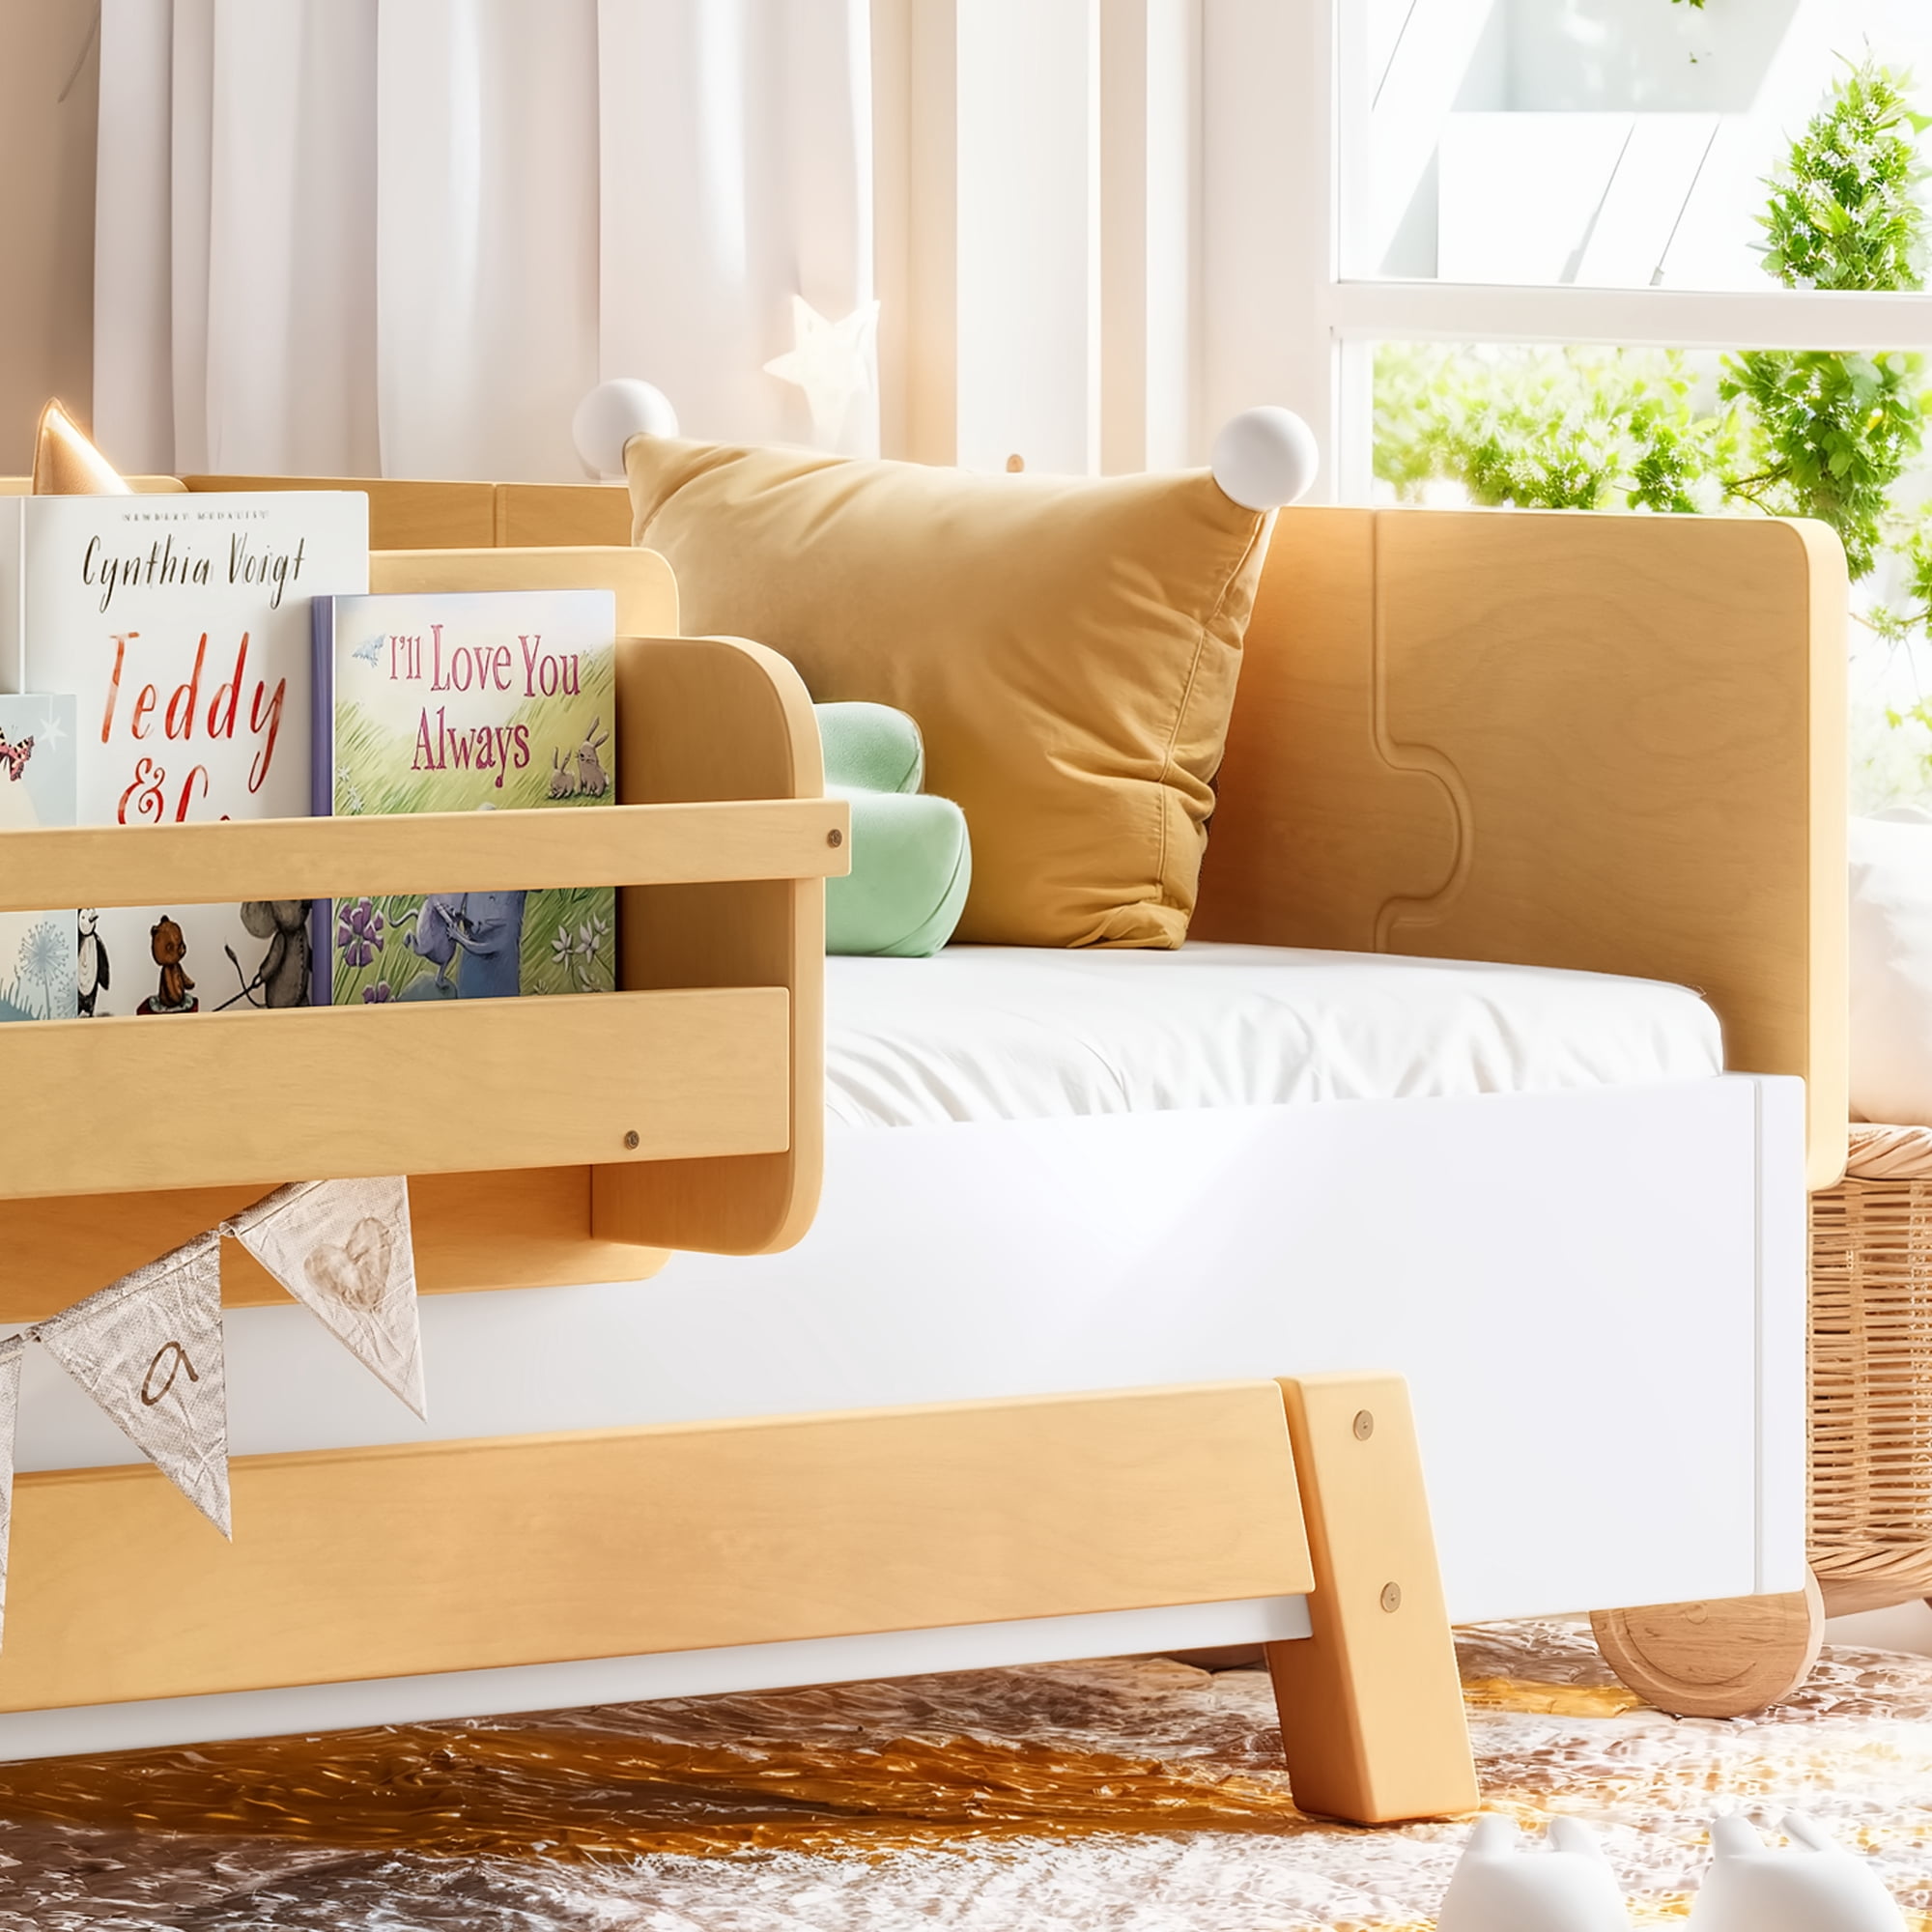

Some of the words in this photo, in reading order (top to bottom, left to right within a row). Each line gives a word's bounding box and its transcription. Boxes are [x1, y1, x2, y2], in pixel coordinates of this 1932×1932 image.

[82, 534, 211, 613] Cynthia
[228, 532, 305, 611] Voigt
[389, 635, 422, 680] I'll
[430, 624, 513, 692] Love
[518, 635, 581, 697] You
[100, 631, 287, 794] Teddy
[410, 705, 531, 788] Always
